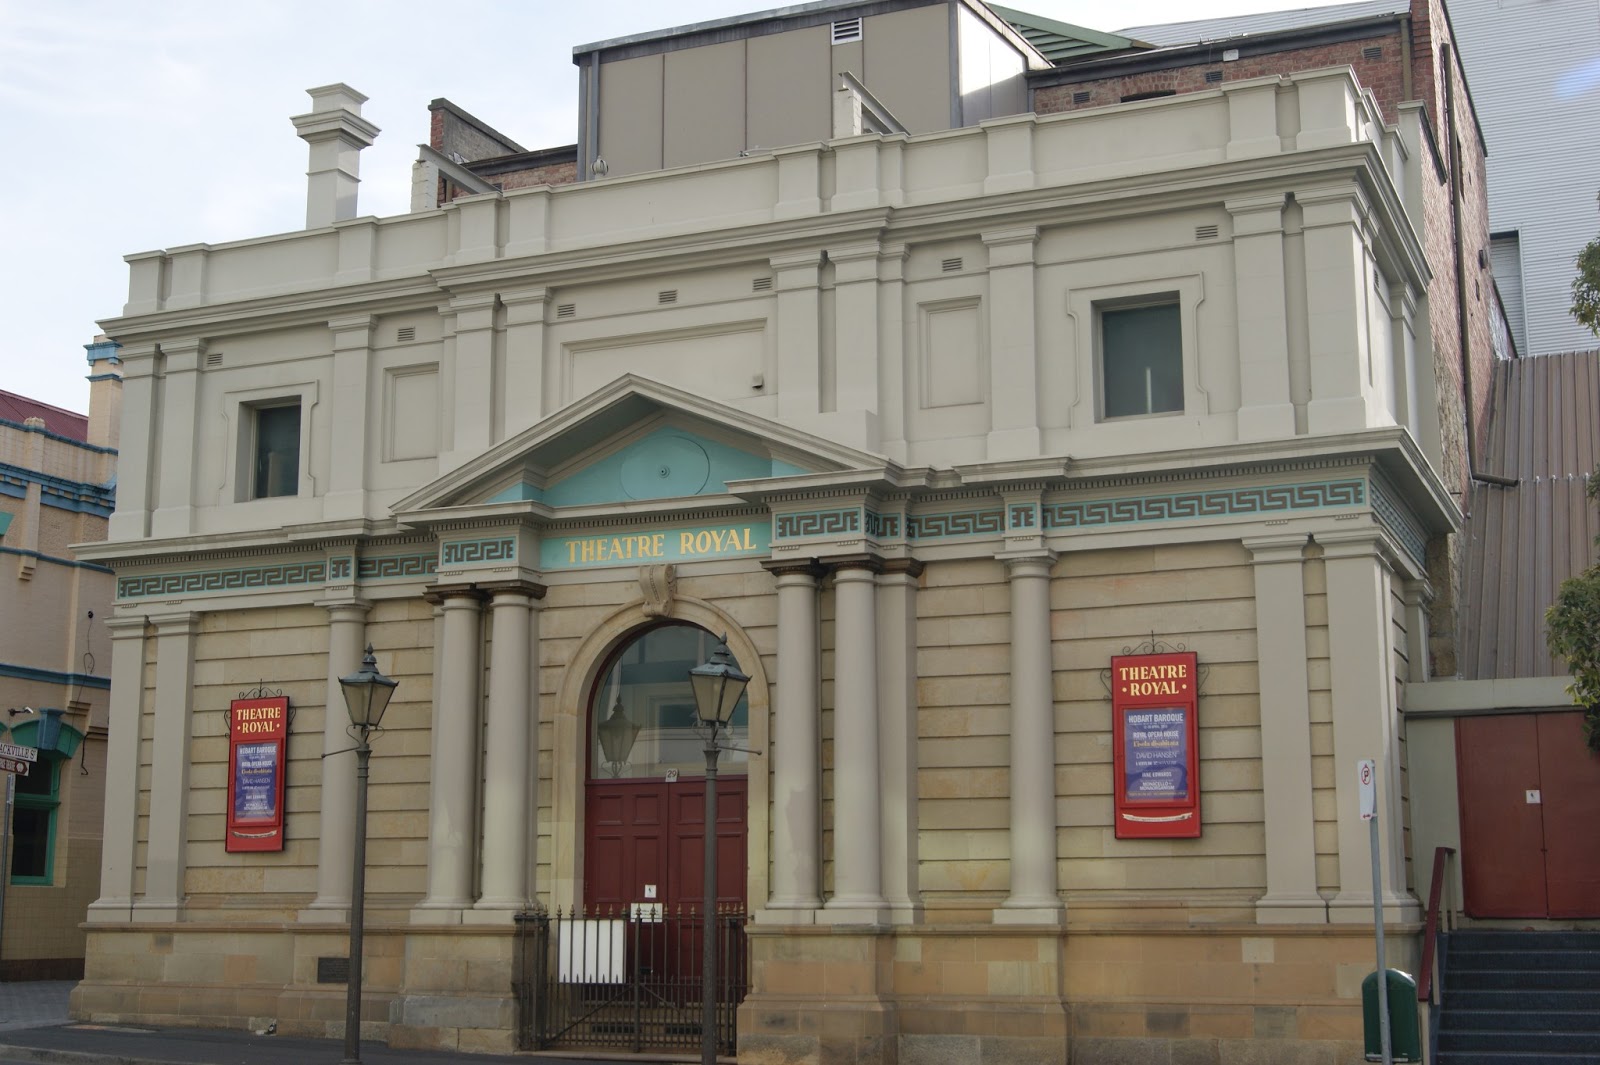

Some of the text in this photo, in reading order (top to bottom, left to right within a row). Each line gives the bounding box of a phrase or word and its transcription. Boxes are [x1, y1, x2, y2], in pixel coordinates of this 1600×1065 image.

[566, 528, 757, 563] THEATRE ROYAL
[1120, 664, 1187, 680] THEATRE
[236, 706, 281, 720] THEATRE
[1128, 713, 1184, 723] HOBART BAROQUE
